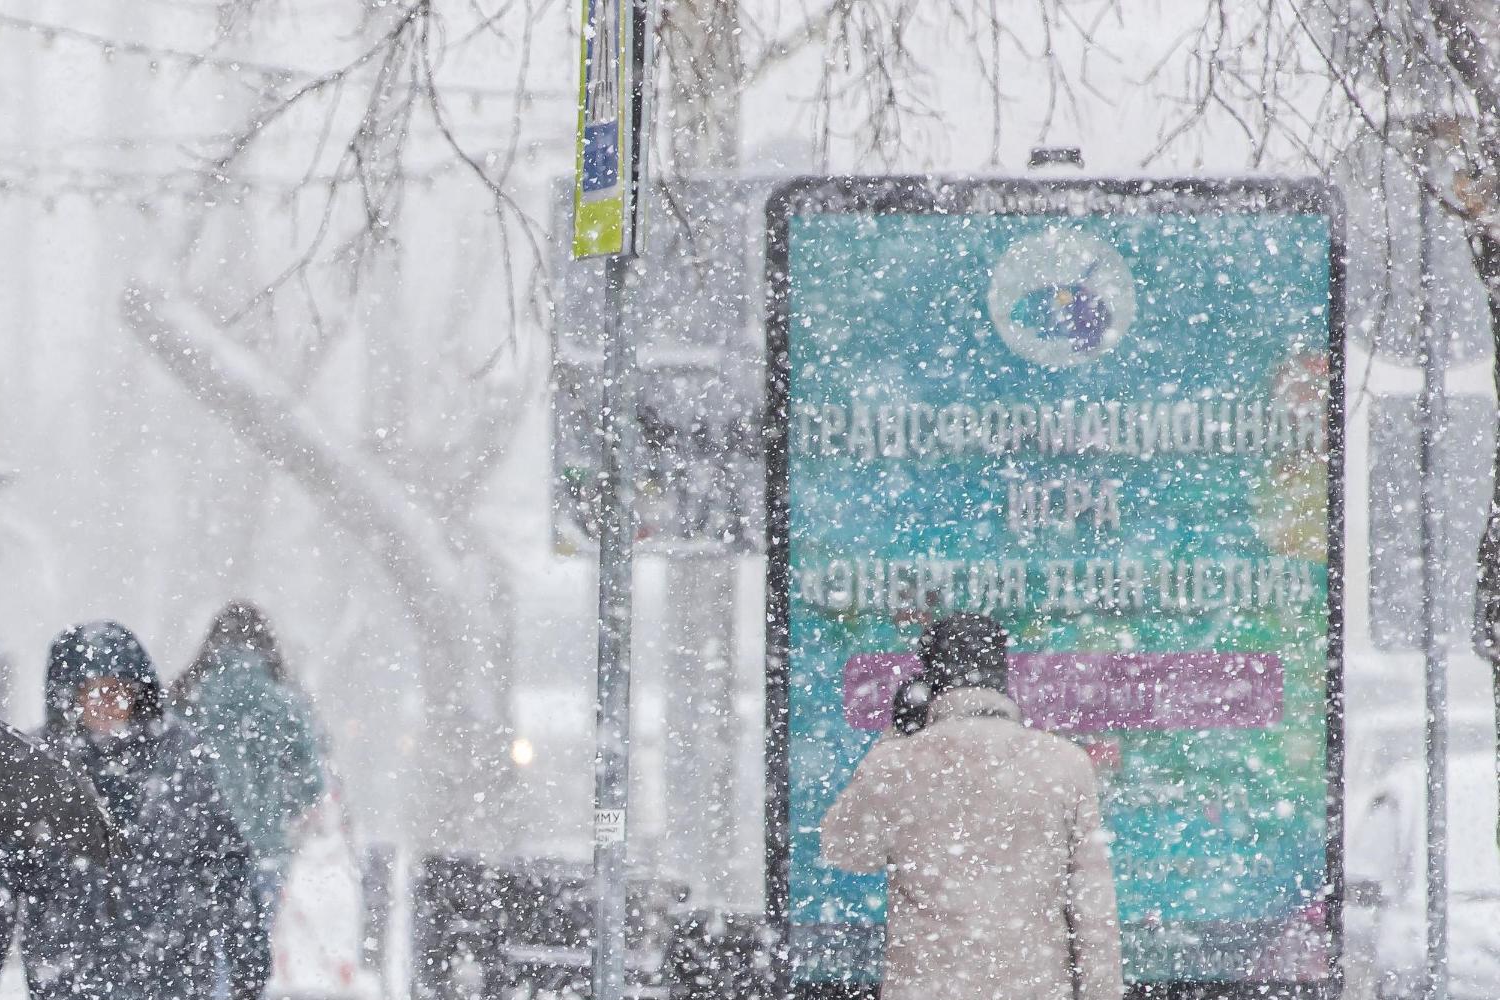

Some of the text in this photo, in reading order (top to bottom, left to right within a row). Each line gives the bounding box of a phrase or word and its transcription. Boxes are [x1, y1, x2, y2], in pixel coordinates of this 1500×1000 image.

[799, 400, 1324, 456] ТРАНСФОРМАЦИОННАЯ
[1008, 478, 1121, 532] ИГРА
[1044, 558, 1146, 610] ДЛЯ
